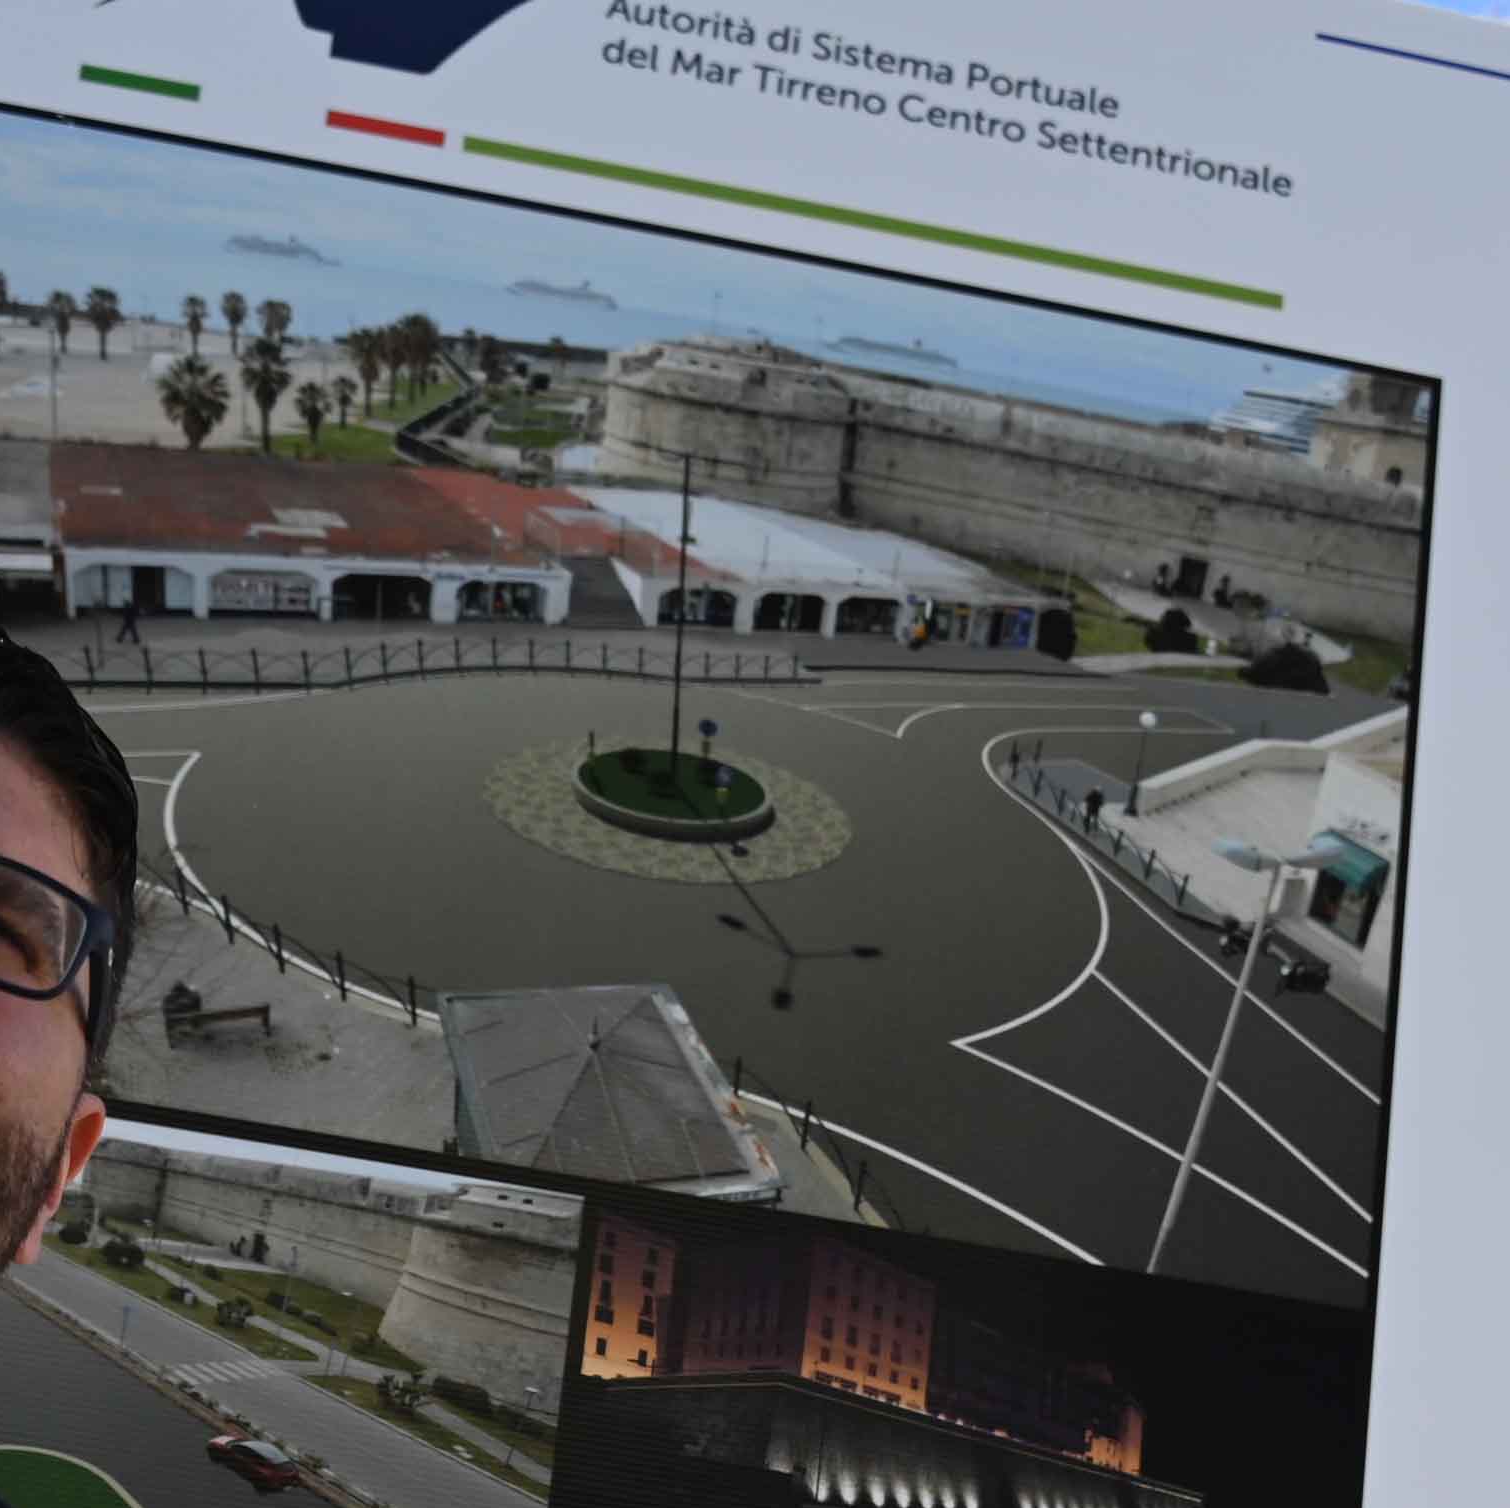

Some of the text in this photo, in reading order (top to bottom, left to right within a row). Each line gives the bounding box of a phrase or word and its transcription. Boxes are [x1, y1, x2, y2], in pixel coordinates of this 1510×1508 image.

[602, 39, 1292, 198] del Mar Tirreno Centro Settentrionale
[605, 0, 1119, 119] Autorità di Sistema Portuale
